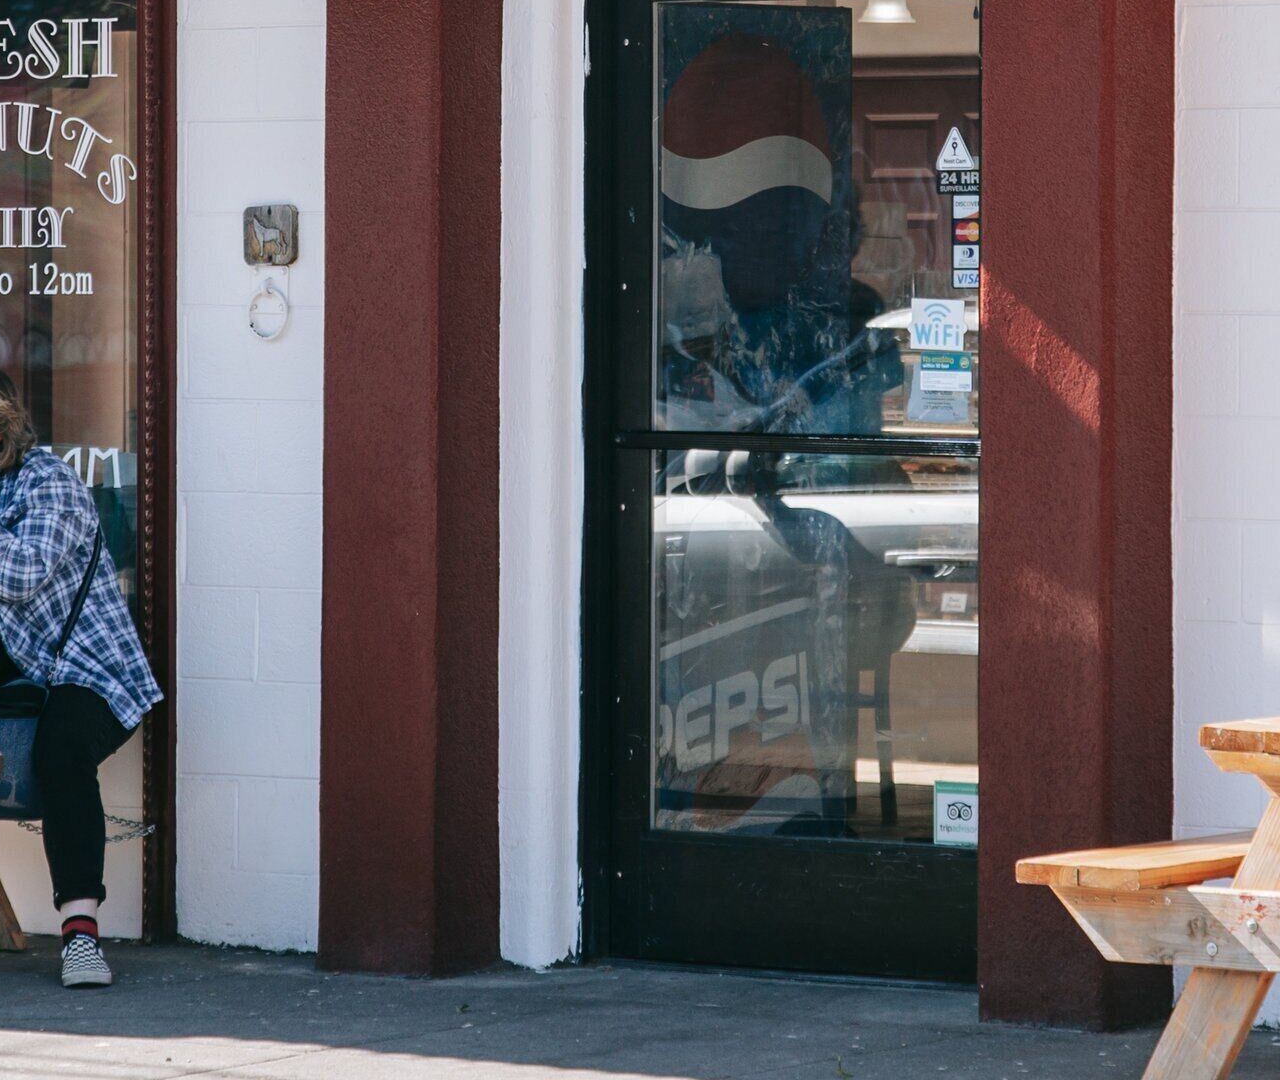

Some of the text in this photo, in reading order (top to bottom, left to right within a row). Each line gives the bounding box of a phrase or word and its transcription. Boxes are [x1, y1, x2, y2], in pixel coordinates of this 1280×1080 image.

[940, 172, 958, 185] 24
[940, 185, 979, 193] SURVEILLANC
[29, 263, 94, 295] 12pm
[914, 323, 960, 347] WiFi
